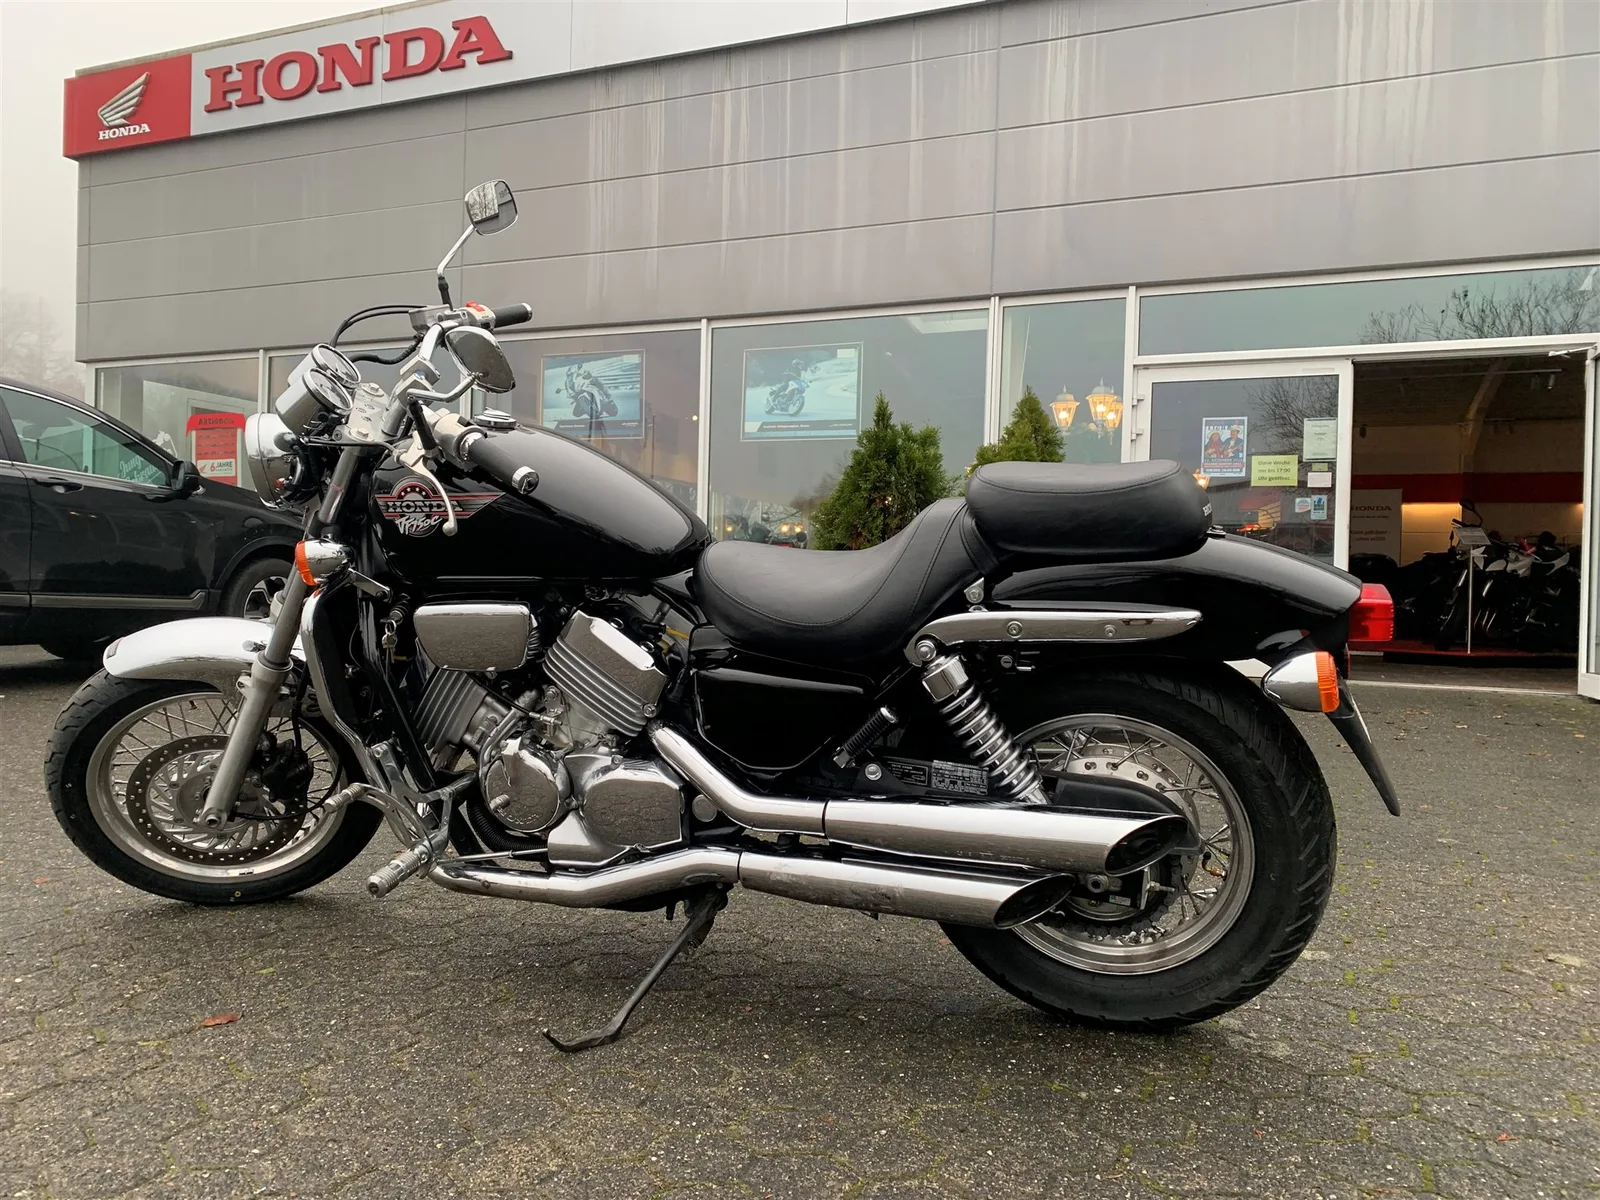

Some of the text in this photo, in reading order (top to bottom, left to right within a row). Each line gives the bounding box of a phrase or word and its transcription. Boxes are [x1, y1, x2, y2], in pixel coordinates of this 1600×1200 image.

[204, 15, 513, 114] HONDA
[98, 122, 151, 140] HONDA
[210, 462, 216, 472] 6
[387, 501, 463, 513] HONDA
